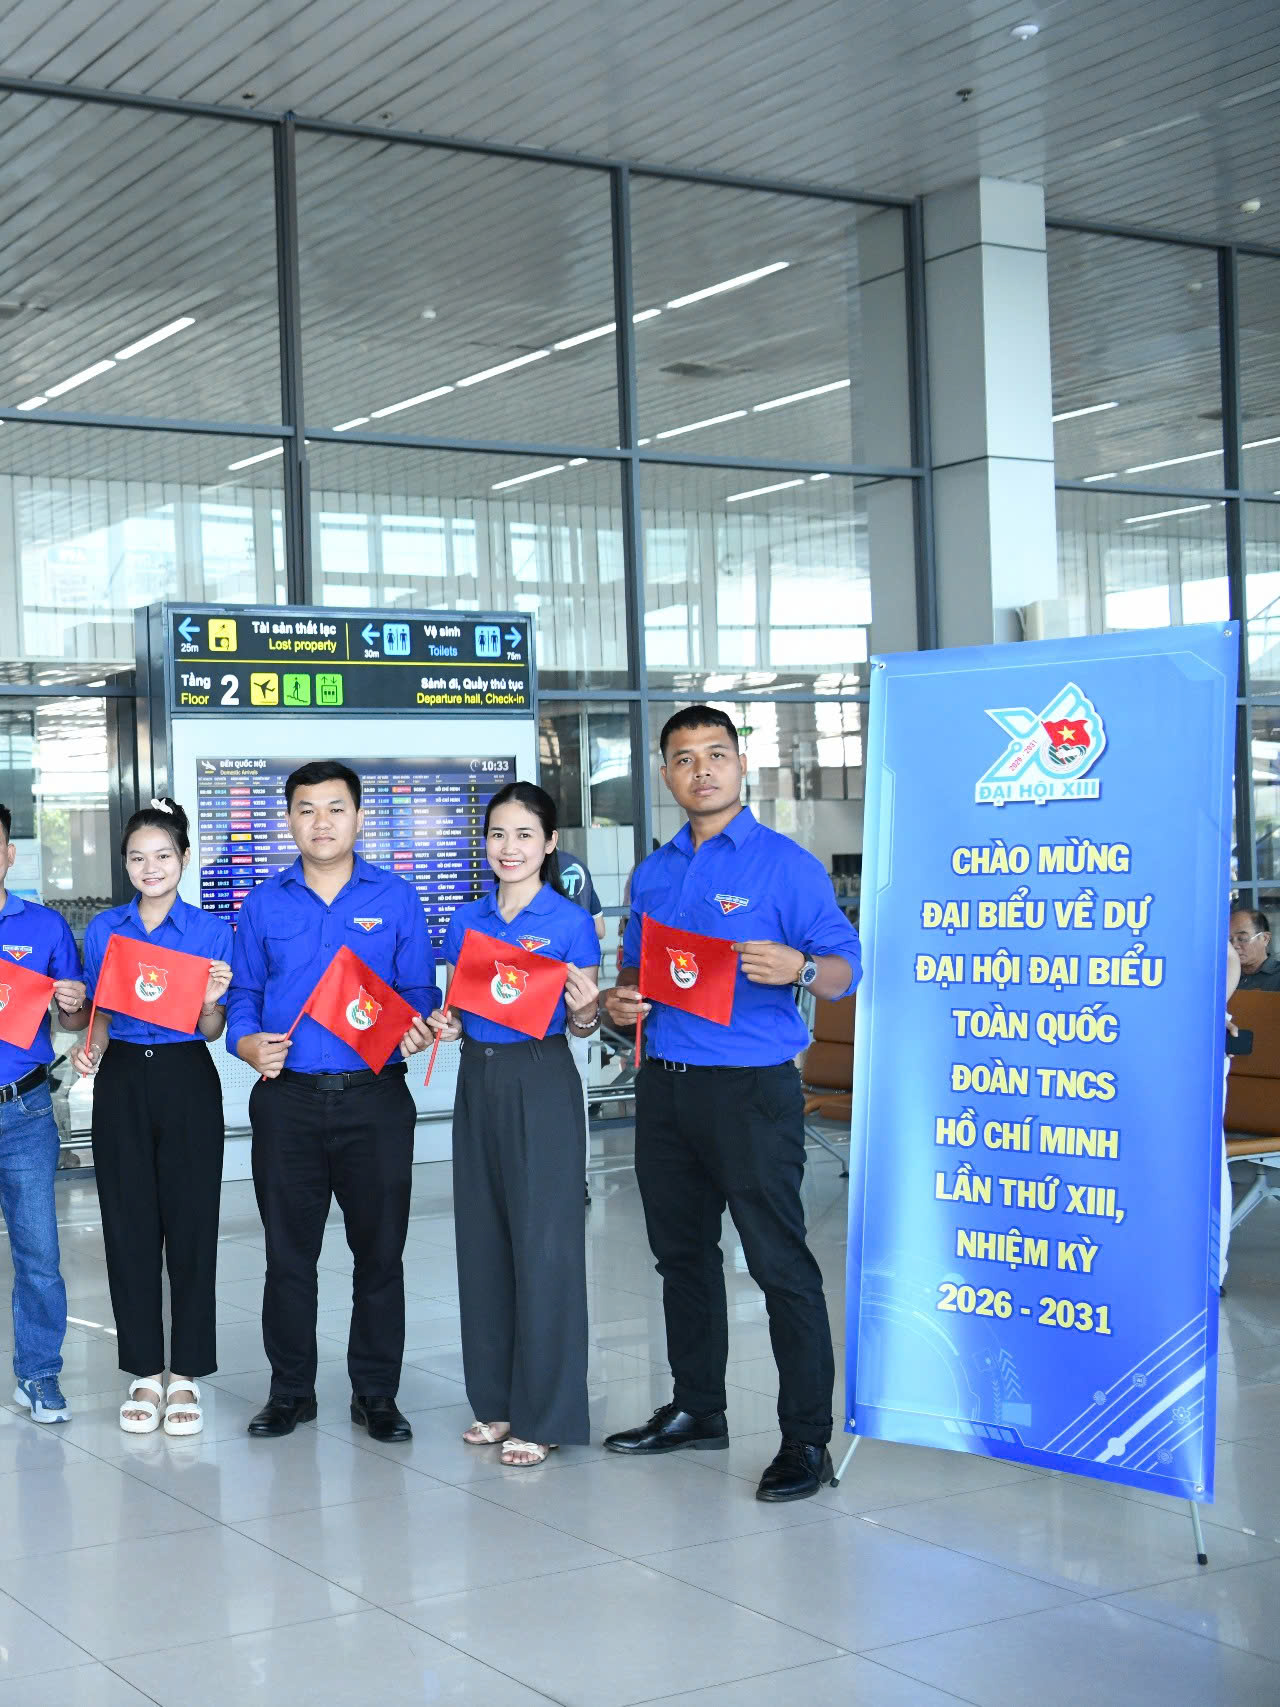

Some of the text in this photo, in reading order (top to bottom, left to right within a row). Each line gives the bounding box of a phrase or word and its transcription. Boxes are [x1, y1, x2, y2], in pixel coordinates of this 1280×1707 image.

[252, 620, 337, 637] Tài sản thất lạc
[424, 625, 461, 638] Vệ sinh
[181, 643, 199, 653] 25m
[269, 638, 337, 653] Lost property
[364, 649, 380, 658] 30m
[428, 645, 458, 656] Toilets
[181, 672, 240, 706] Tầng 2
[421, 676, 524, 692] Sảnh đi, Quầy thủ tục
[181, 693, 209, 705] Floor
[417, 693, 525, 706] Departure hall, Check-in
[235, 759, 253, 769] QUỐC
[481, 761, 509, 771] 10:33
[979, 781, 1096, 803] ĐẠI HỘI XIII
[952, 838, 1129, 874] CHÀO MỪNG
[922, 887, 1152, 935] ĐẠI BIỂU VỀ DỰ
[916, 944, 1163, 990] ĐẠI HỘI ĐẠI BIỂU
[952, 1003, 1118, 1046] TOÀN QUỐC
[952, 1060, 1116, 1100] ĐOÀN TNCS
[935, 1108, 1118, 1158] HỒ CHÍ MINH
[935, 1164, 1125, 1223] LẦN THỨ XIII,
[957, 1229, 1098, 1272] NHIỆM KỲ
[938, 1283, 1012, 1318] 2026
[1038, 1297, 1111, 1335] 2031
